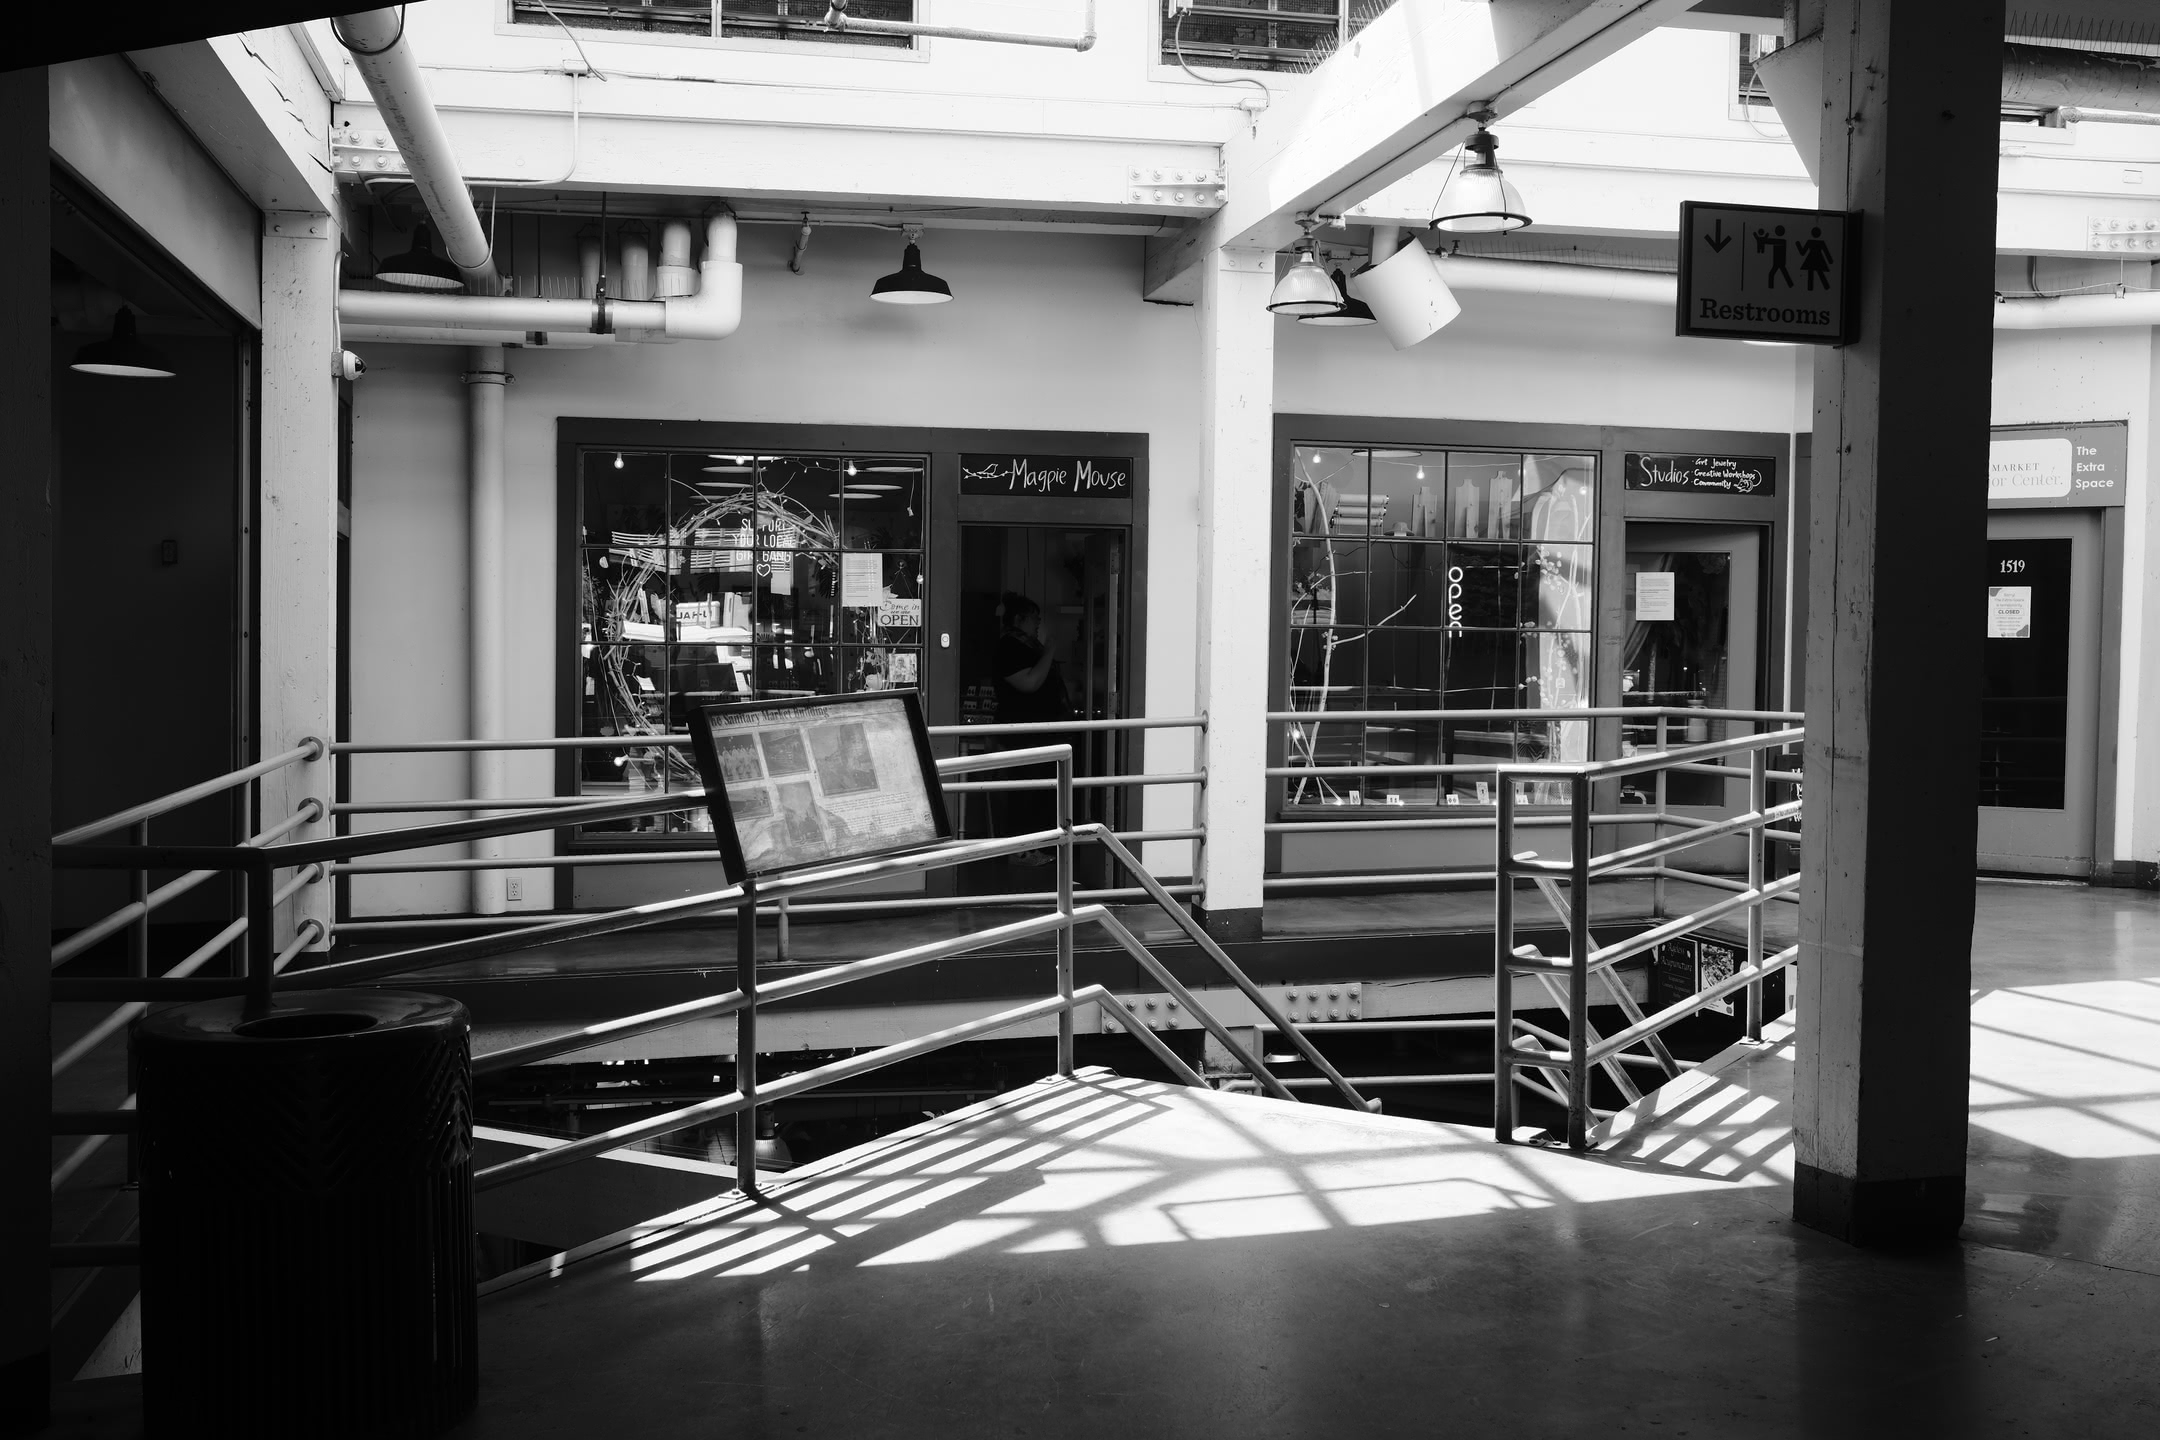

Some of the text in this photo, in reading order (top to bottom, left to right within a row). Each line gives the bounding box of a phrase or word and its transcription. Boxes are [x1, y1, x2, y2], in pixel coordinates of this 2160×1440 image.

[1699, 298, 1831, 326] Restrooms
[2076, 446, 2097, 456] The
[1711, 458, 1737, 470] Jewelry
[1991, 463, 2040, 473] MARKET
[2076, 462, 2105, 472] Extra
[1008, 458, 1127, 493] Magpie Mouse
[1639, 456, 1690, 488] Studios
[1694, 468, 1756, 480] Creative Workshops
[1693, 479, 1731, 489] Community
[2075, 478, 2114, 490] Space
[2000, 560, 2025, 573] 1519
[880, 614, 919, 625] OPEN
[724, 711, 761, 726] Sanitary
